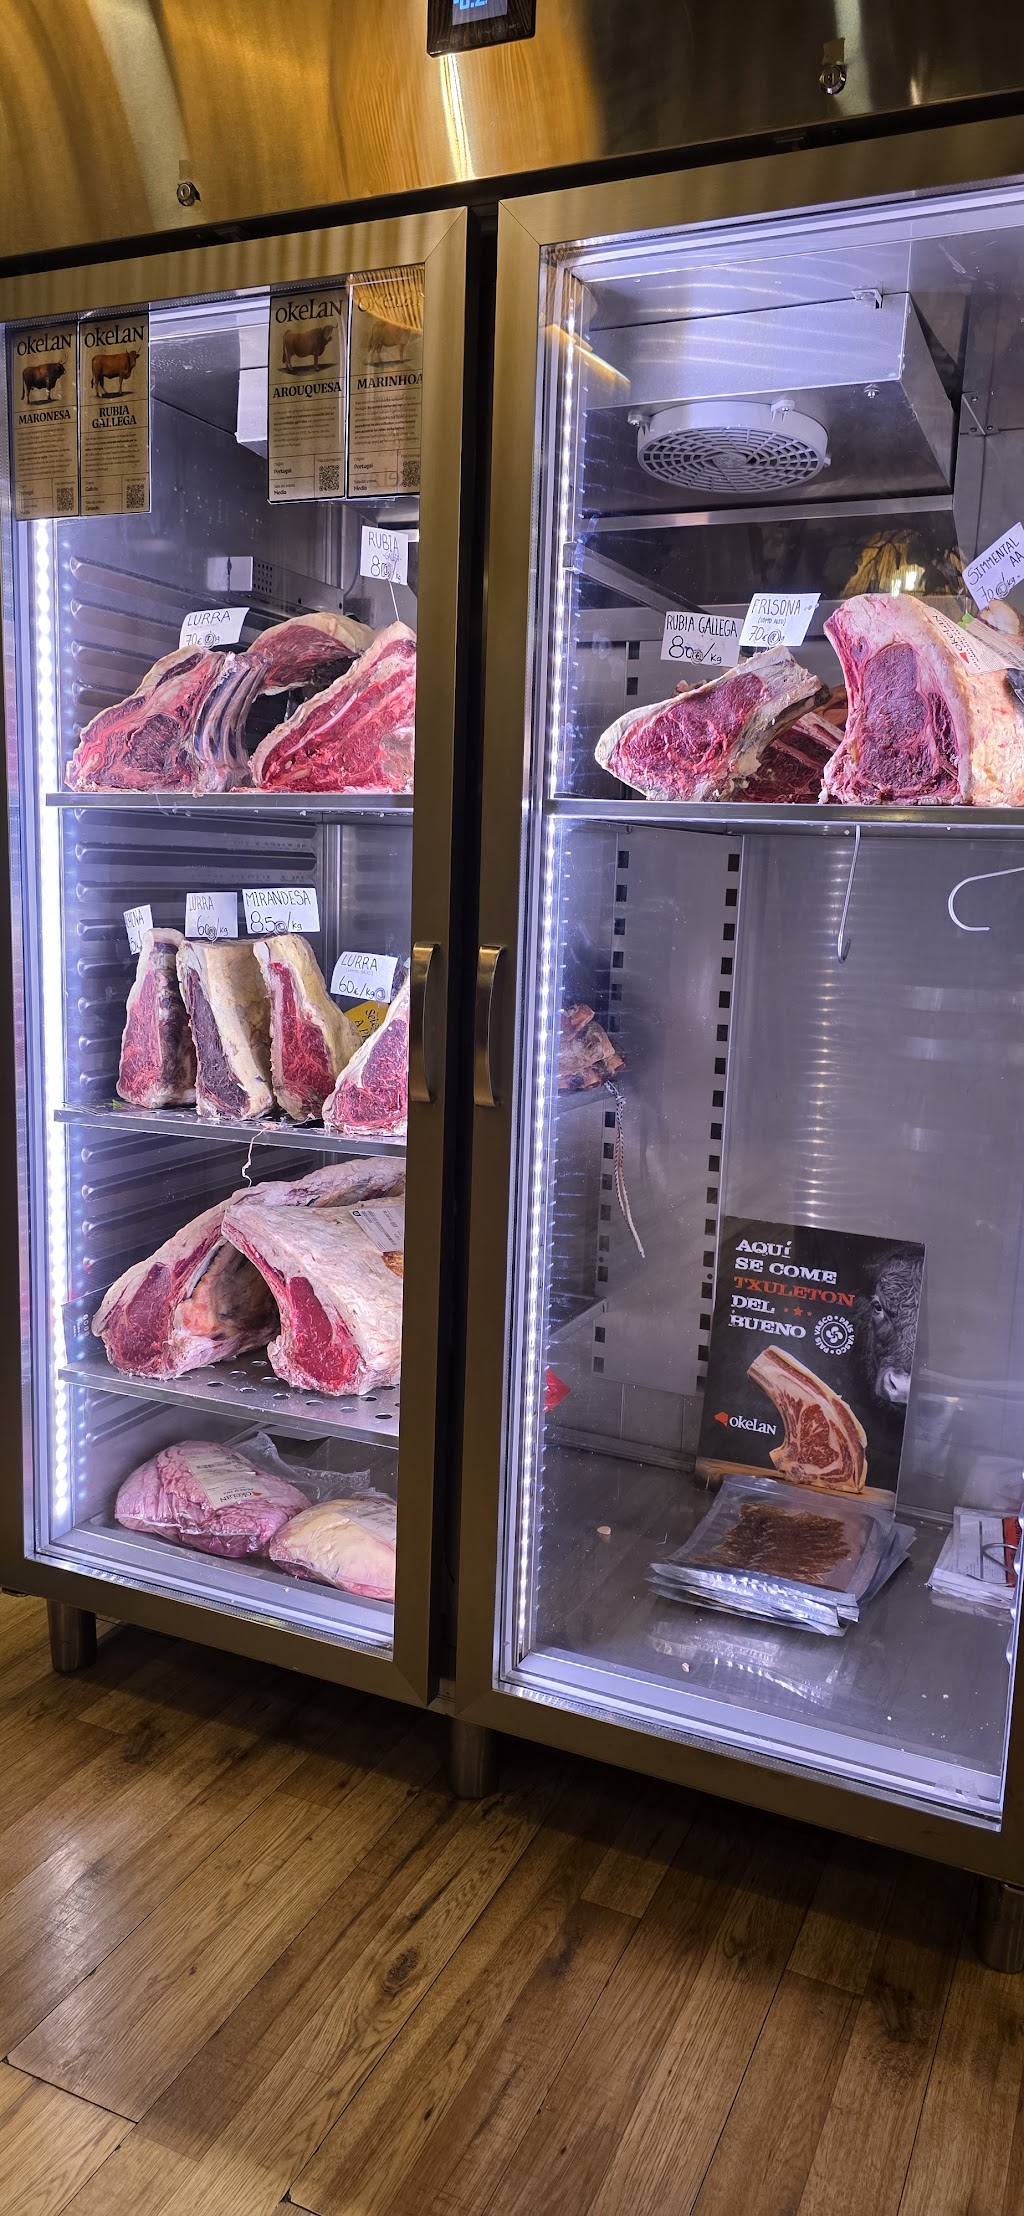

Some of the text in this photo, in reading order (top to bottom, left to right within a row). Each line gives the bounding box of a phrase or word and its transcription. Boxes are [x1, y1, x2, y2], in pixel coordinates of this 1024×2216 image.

[273, 382, 342, 398] AROUQUESA
[357, 373, 423, 389] MARINHOA
[18, 409, 71, 426] MARONESA
[99, 405, 130, 418] RUBIA
[92, 416, 137, 429] GALLEGA
[368, 531, 400, 553] RUBIA
[967, 537, 1020, 586] SIMMENTAL
[1009, 551, 1024, 568] AA
[751, 598, 801, 616] FRISONA
[187, 610, 231, 627] LURRA
[666, 614, 738, 638] RUBIA GALLEGA
[189, 896, 215, 911] LURRA
[245, 890, 311, 907] MIRANDESA
[340, 954, 378, 972] LURRA
[338, 976, 375, 1000] 60€/kg
[735, 1238, 792, 1259] AQUÍ
[734, 1257, 837, 1285] SE COME
[733, 1276, 856, 1308] TXULETON
[731, 1294, 775, 1315] DEL
[728, 1315, 806, 1339] BUENO
[814, 1315, 833, 1354] PAÍS VASCO
[835, 1316, 855, 1356] PAÍS VASCO
